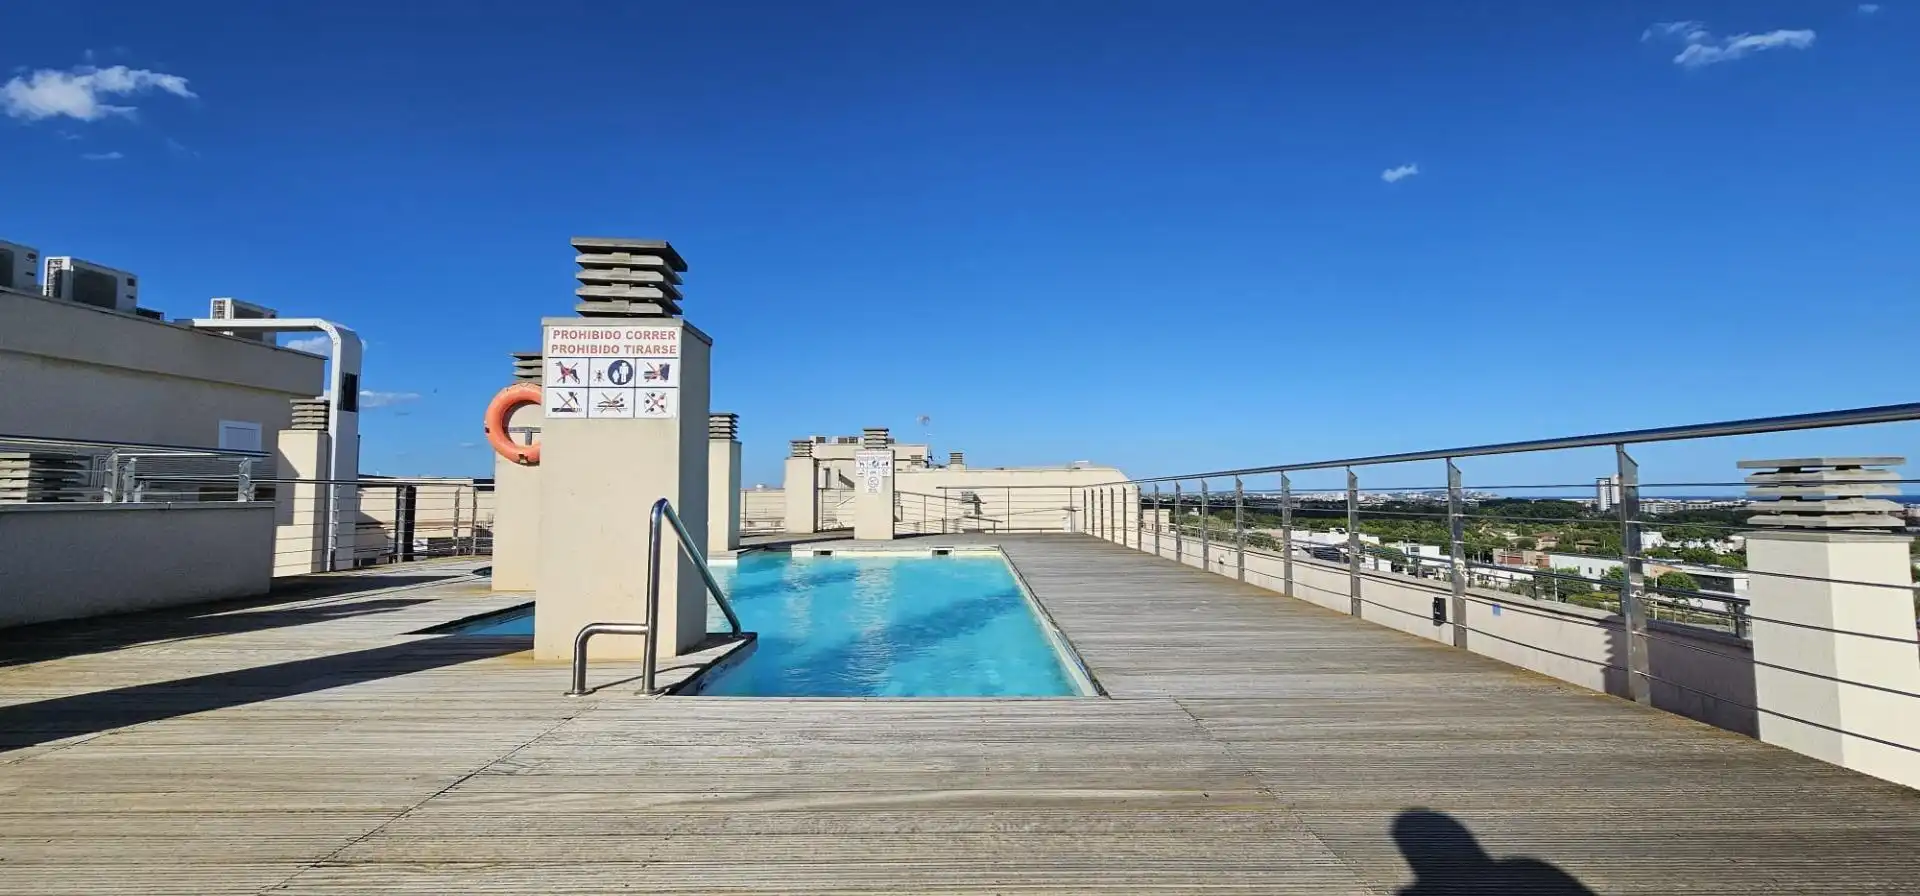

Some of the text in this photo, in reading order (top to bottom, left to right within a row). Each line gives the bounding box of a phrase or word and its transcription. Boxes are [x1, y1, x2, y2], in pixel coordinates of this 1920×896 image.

[553, 330, 676, 340] PROHIBIDO CORRER
[551, 344, 677, 354] PROHIBIDO TIRARSE
